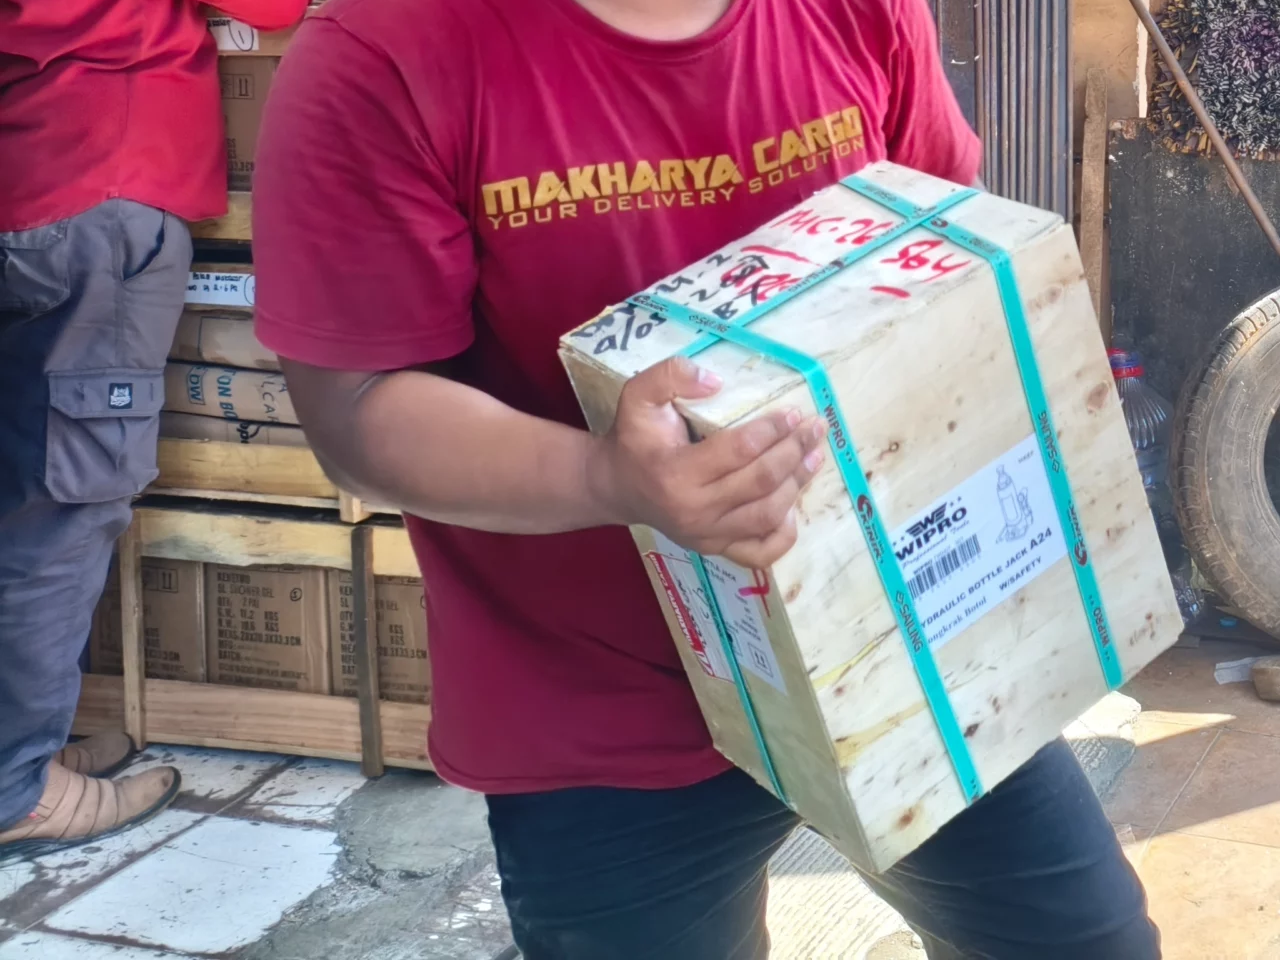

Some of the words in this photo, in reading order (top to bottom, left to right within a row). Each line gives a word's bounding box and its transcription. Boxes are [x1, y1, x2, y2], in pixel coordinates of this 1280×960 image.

[482, 154, 744, 216] MAKHARYA
[753, 106, 862, 174] CARGO
[487, 203, 578, 230] YOUR
[594, 187, 735, 215] DELIVERY
[748, 141, 865, 194] SOLUTION
[824, 404, 846, 449] WIPRO
[1038, 410, 1058, 461] SAILING
[895, 507, 967, 560] WIPRO
[921, 592, 966, 630] YDRAULIC
[967, 565, 1003, 596] BOTTLE
[1005, 547, 1028, 569] JACK
[1029, 527, 1053, 551] A24
[999, 556, 1042, 591] W/SAFETY
[899, 603, 923, 653] SAILING
[927, 610, 963, 645] ongkrak
[963, 596, 988, 618] Botol
[1093, 607, 1110, 647] WIPRO
